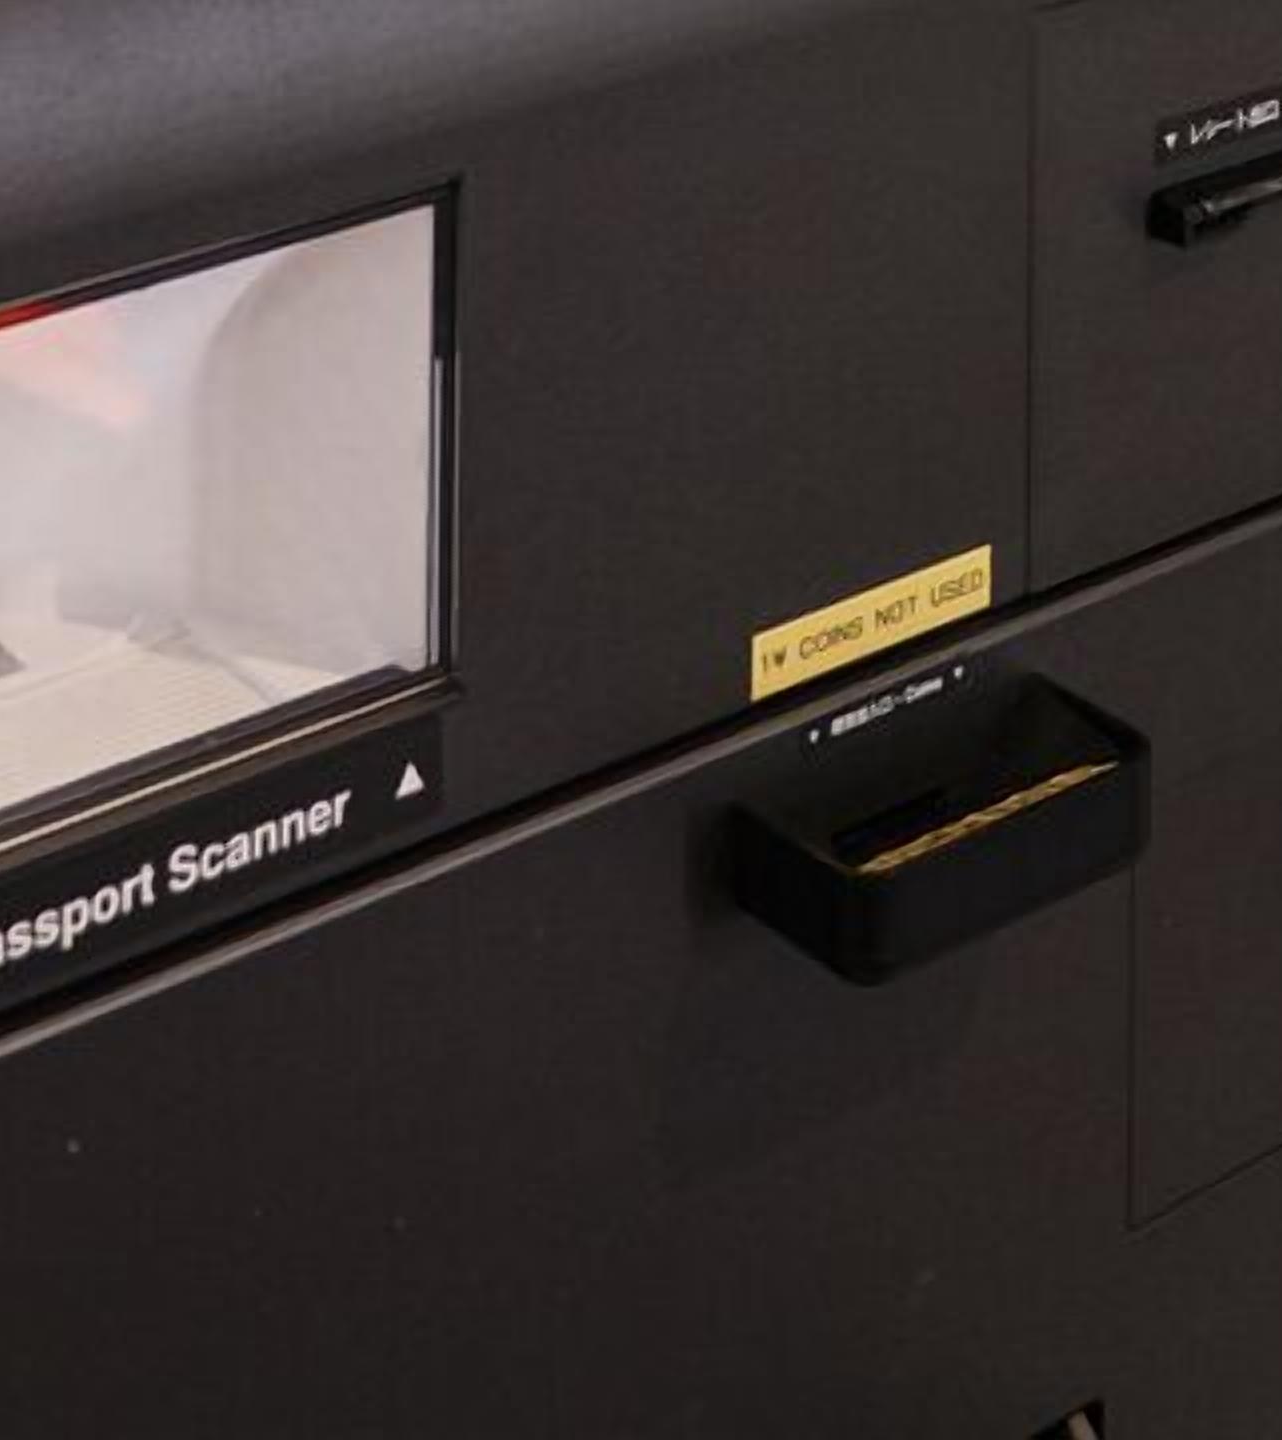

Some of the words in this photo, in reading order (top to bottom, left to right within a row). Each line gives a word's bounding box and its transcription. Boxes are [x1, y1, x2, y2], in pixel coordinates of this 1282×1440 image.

[799, 614, 865, 660] COINS
[874, 595, 919, 633] NOT
[929, 567, 985, 610] USED
[167, 788, 353, 896] Scanner
